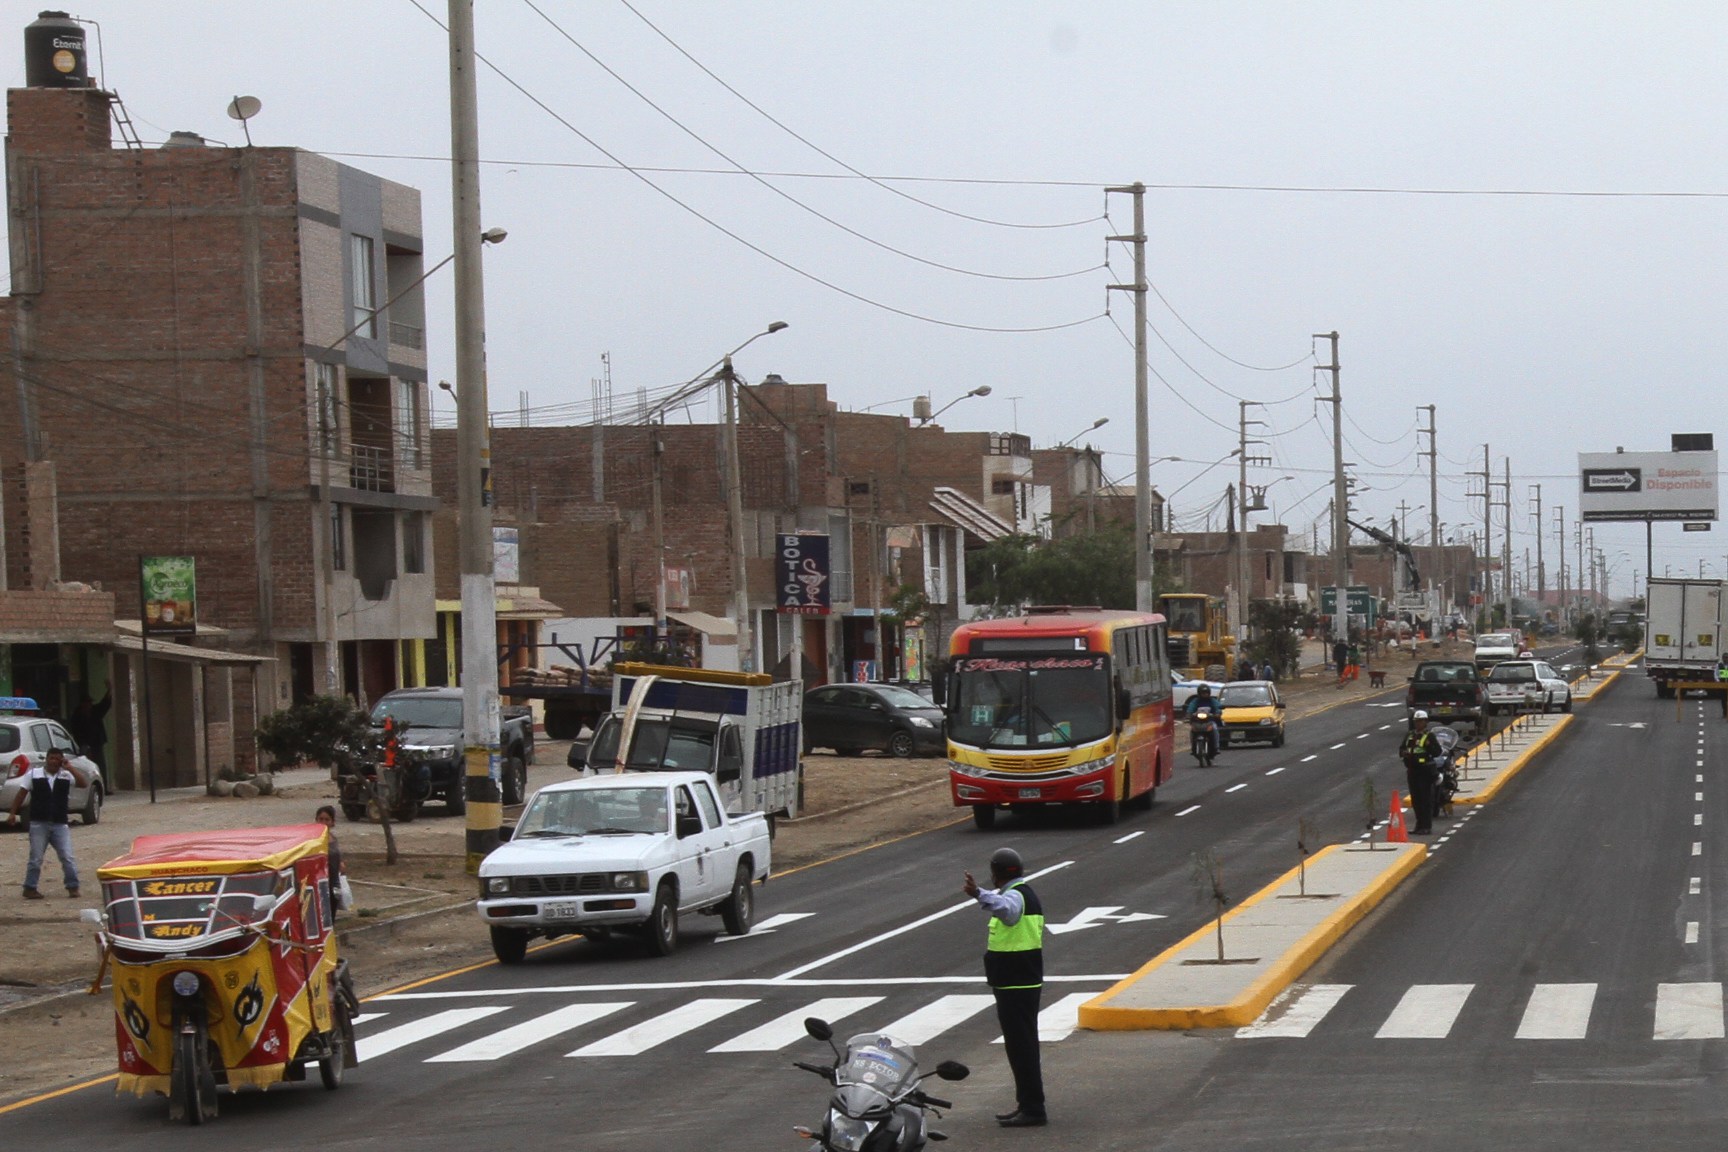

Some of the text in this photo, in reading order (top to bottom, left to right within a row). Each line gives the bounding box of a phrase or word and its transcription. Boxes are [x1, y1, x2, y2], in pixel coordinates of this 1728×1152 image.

[53, 38, 82, 50] Eternit
[1657, 468, 1702, 478] Espacio
[1646, 479, 1713, 490] Disponible
[783, 536, 801, 606] BOTICA
[150, 866, 208, 875] HUANCHACO
[149, 880, 216, 895] Cancer
[155, 924, 202, 937] Andy
